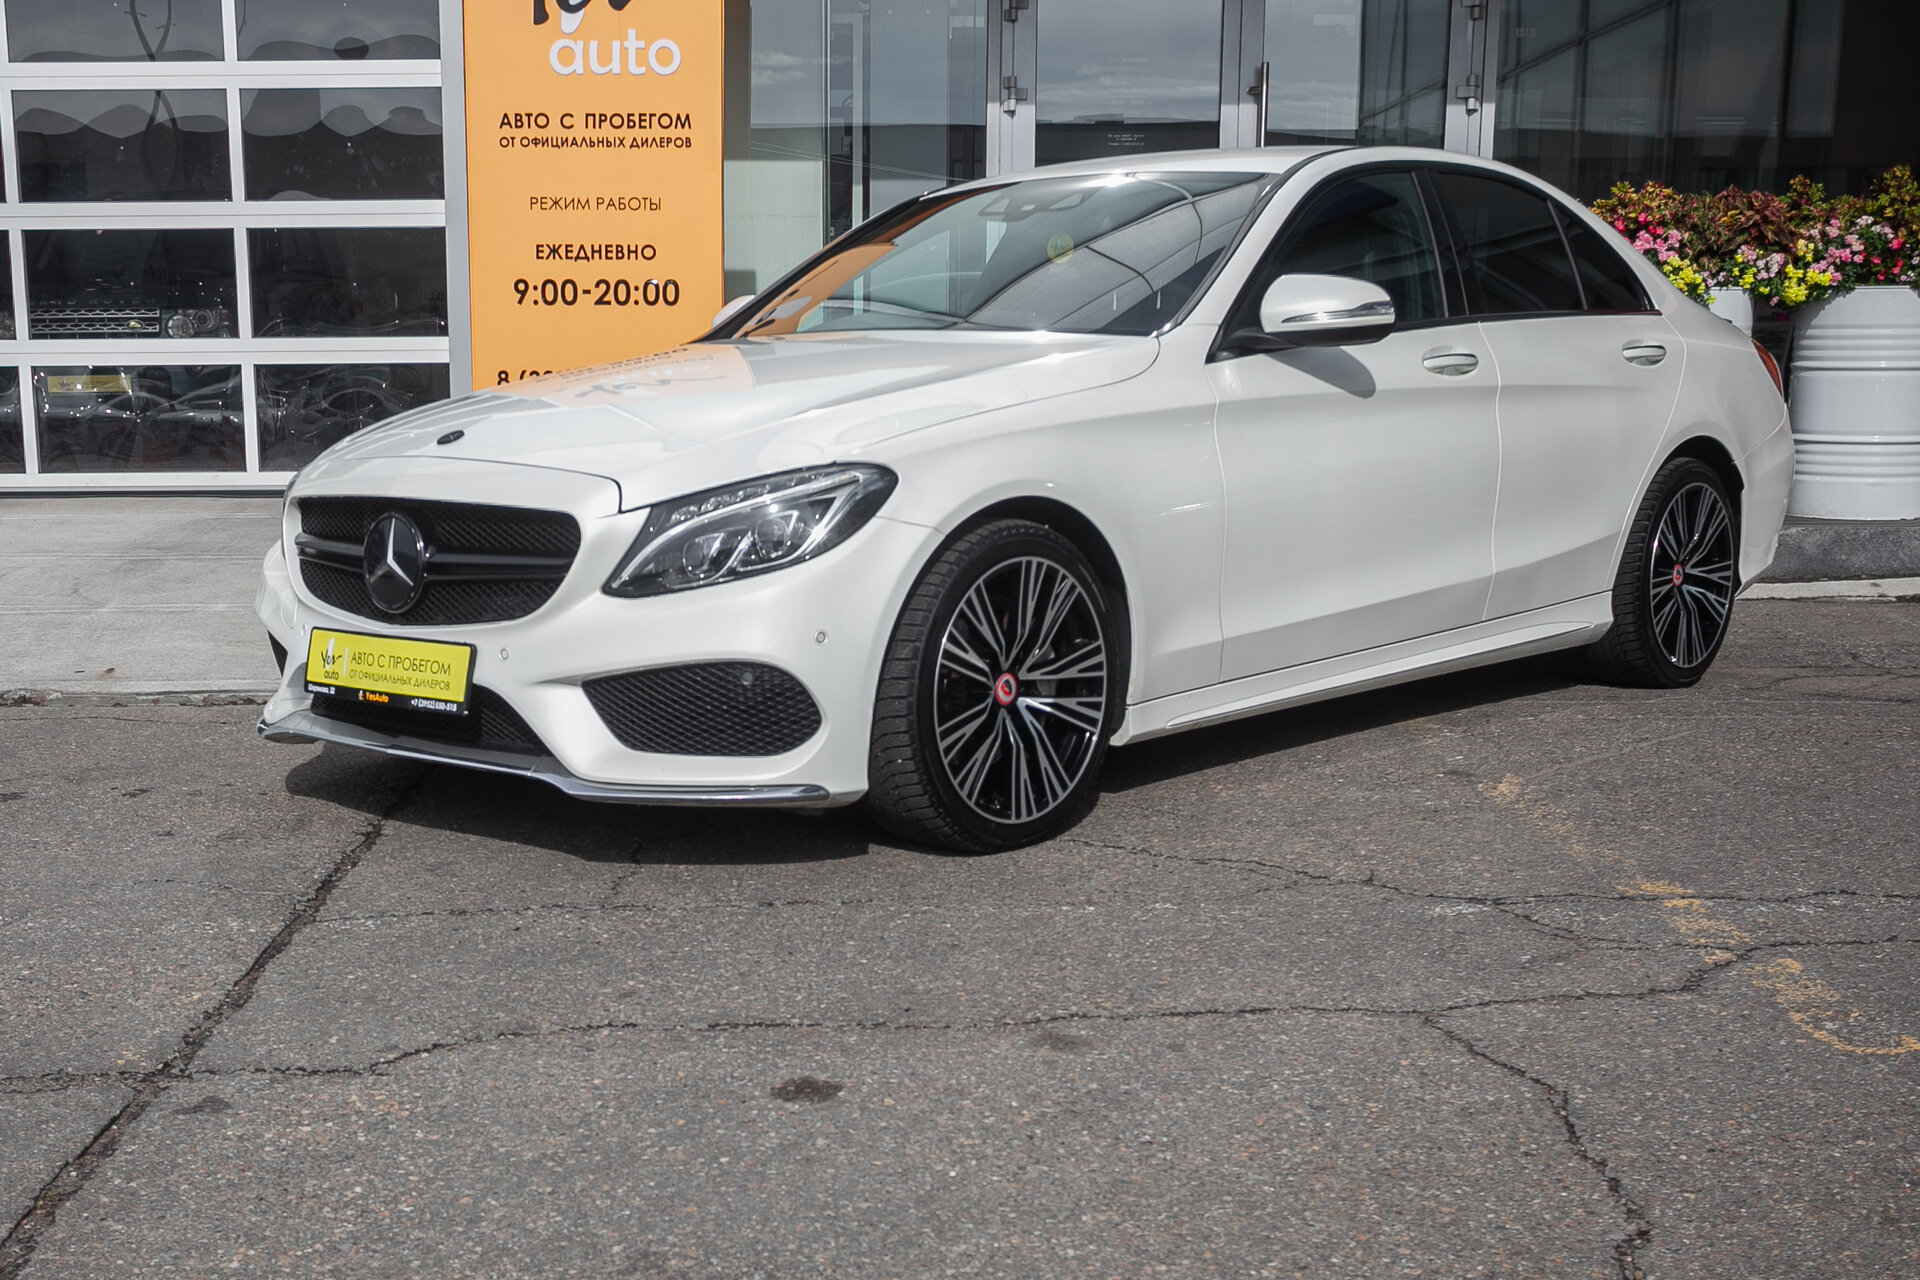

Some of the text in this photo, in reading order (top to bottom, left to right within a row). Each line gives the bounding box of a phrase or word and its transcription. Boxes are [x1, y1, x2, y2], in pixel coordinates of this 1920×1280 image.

[550, 29, 681, 75] auto
[499, 113, 692, 130] АВТО С ПРОБЕГОМ
[499, 136, 692, 149] ОТ ОФИЦИАЛЬНЫХ ДИЛЕРОВ
[530, 196, 662, 211] РЕЖИМ РАБОТЫ
[535, 244, 657, 262] ЕЖЕДНЕВНО
[513, 277, 680, 306] 9:00-20:00
[351, 651, 451, 676] АВТО С ПРОБЕГОМ
[323, 670, 340, 681] auto
[350, 669, 451, 691] ОТ ОФИЦИАЛЬНЫХ ДИЛЕРОВ
[365, 691, 389, 703] YesAuto
